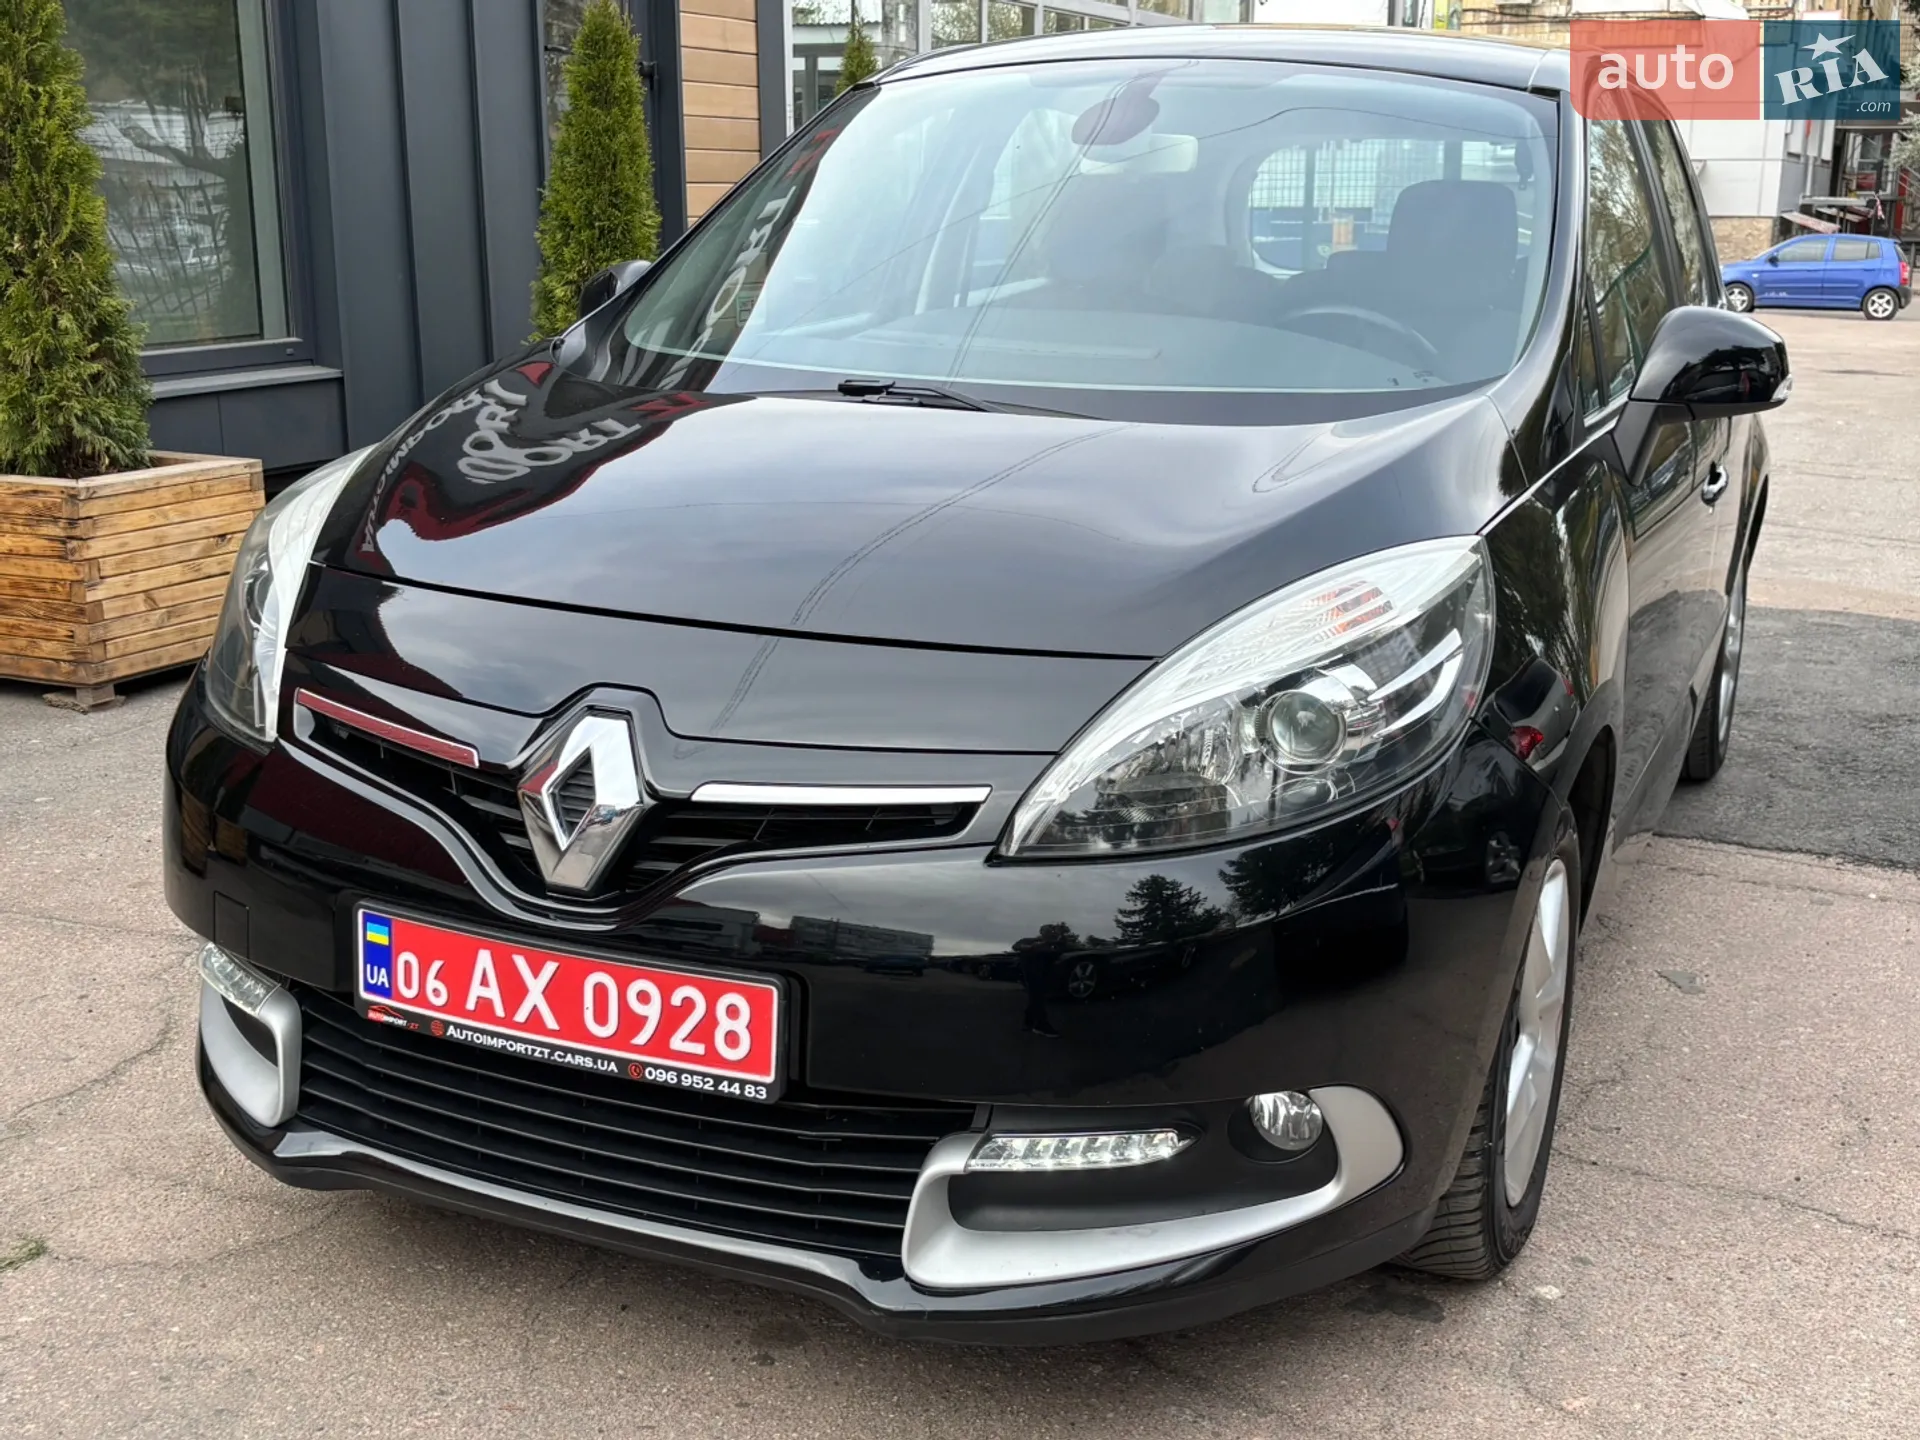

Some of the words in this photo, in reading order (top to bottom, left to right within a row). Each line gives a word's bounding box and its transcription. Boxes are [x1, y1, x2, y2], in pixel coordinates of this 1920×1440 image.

[367, 964, 389, 988] UA
[397, 951, 448, 1007] 06
[466, 949, 560, 1031] AX
[583, 971, 751, 1061] 0928
[446, 1025, 618, 1074] AUTOIMPORTZT.CARS.UA
[645, 1067, 678, 1084] 096
[681, 1074, 714, 1091] 952
[718, 1080, 741, 1095] 44
[744, 1086, 767, 1100] 83
